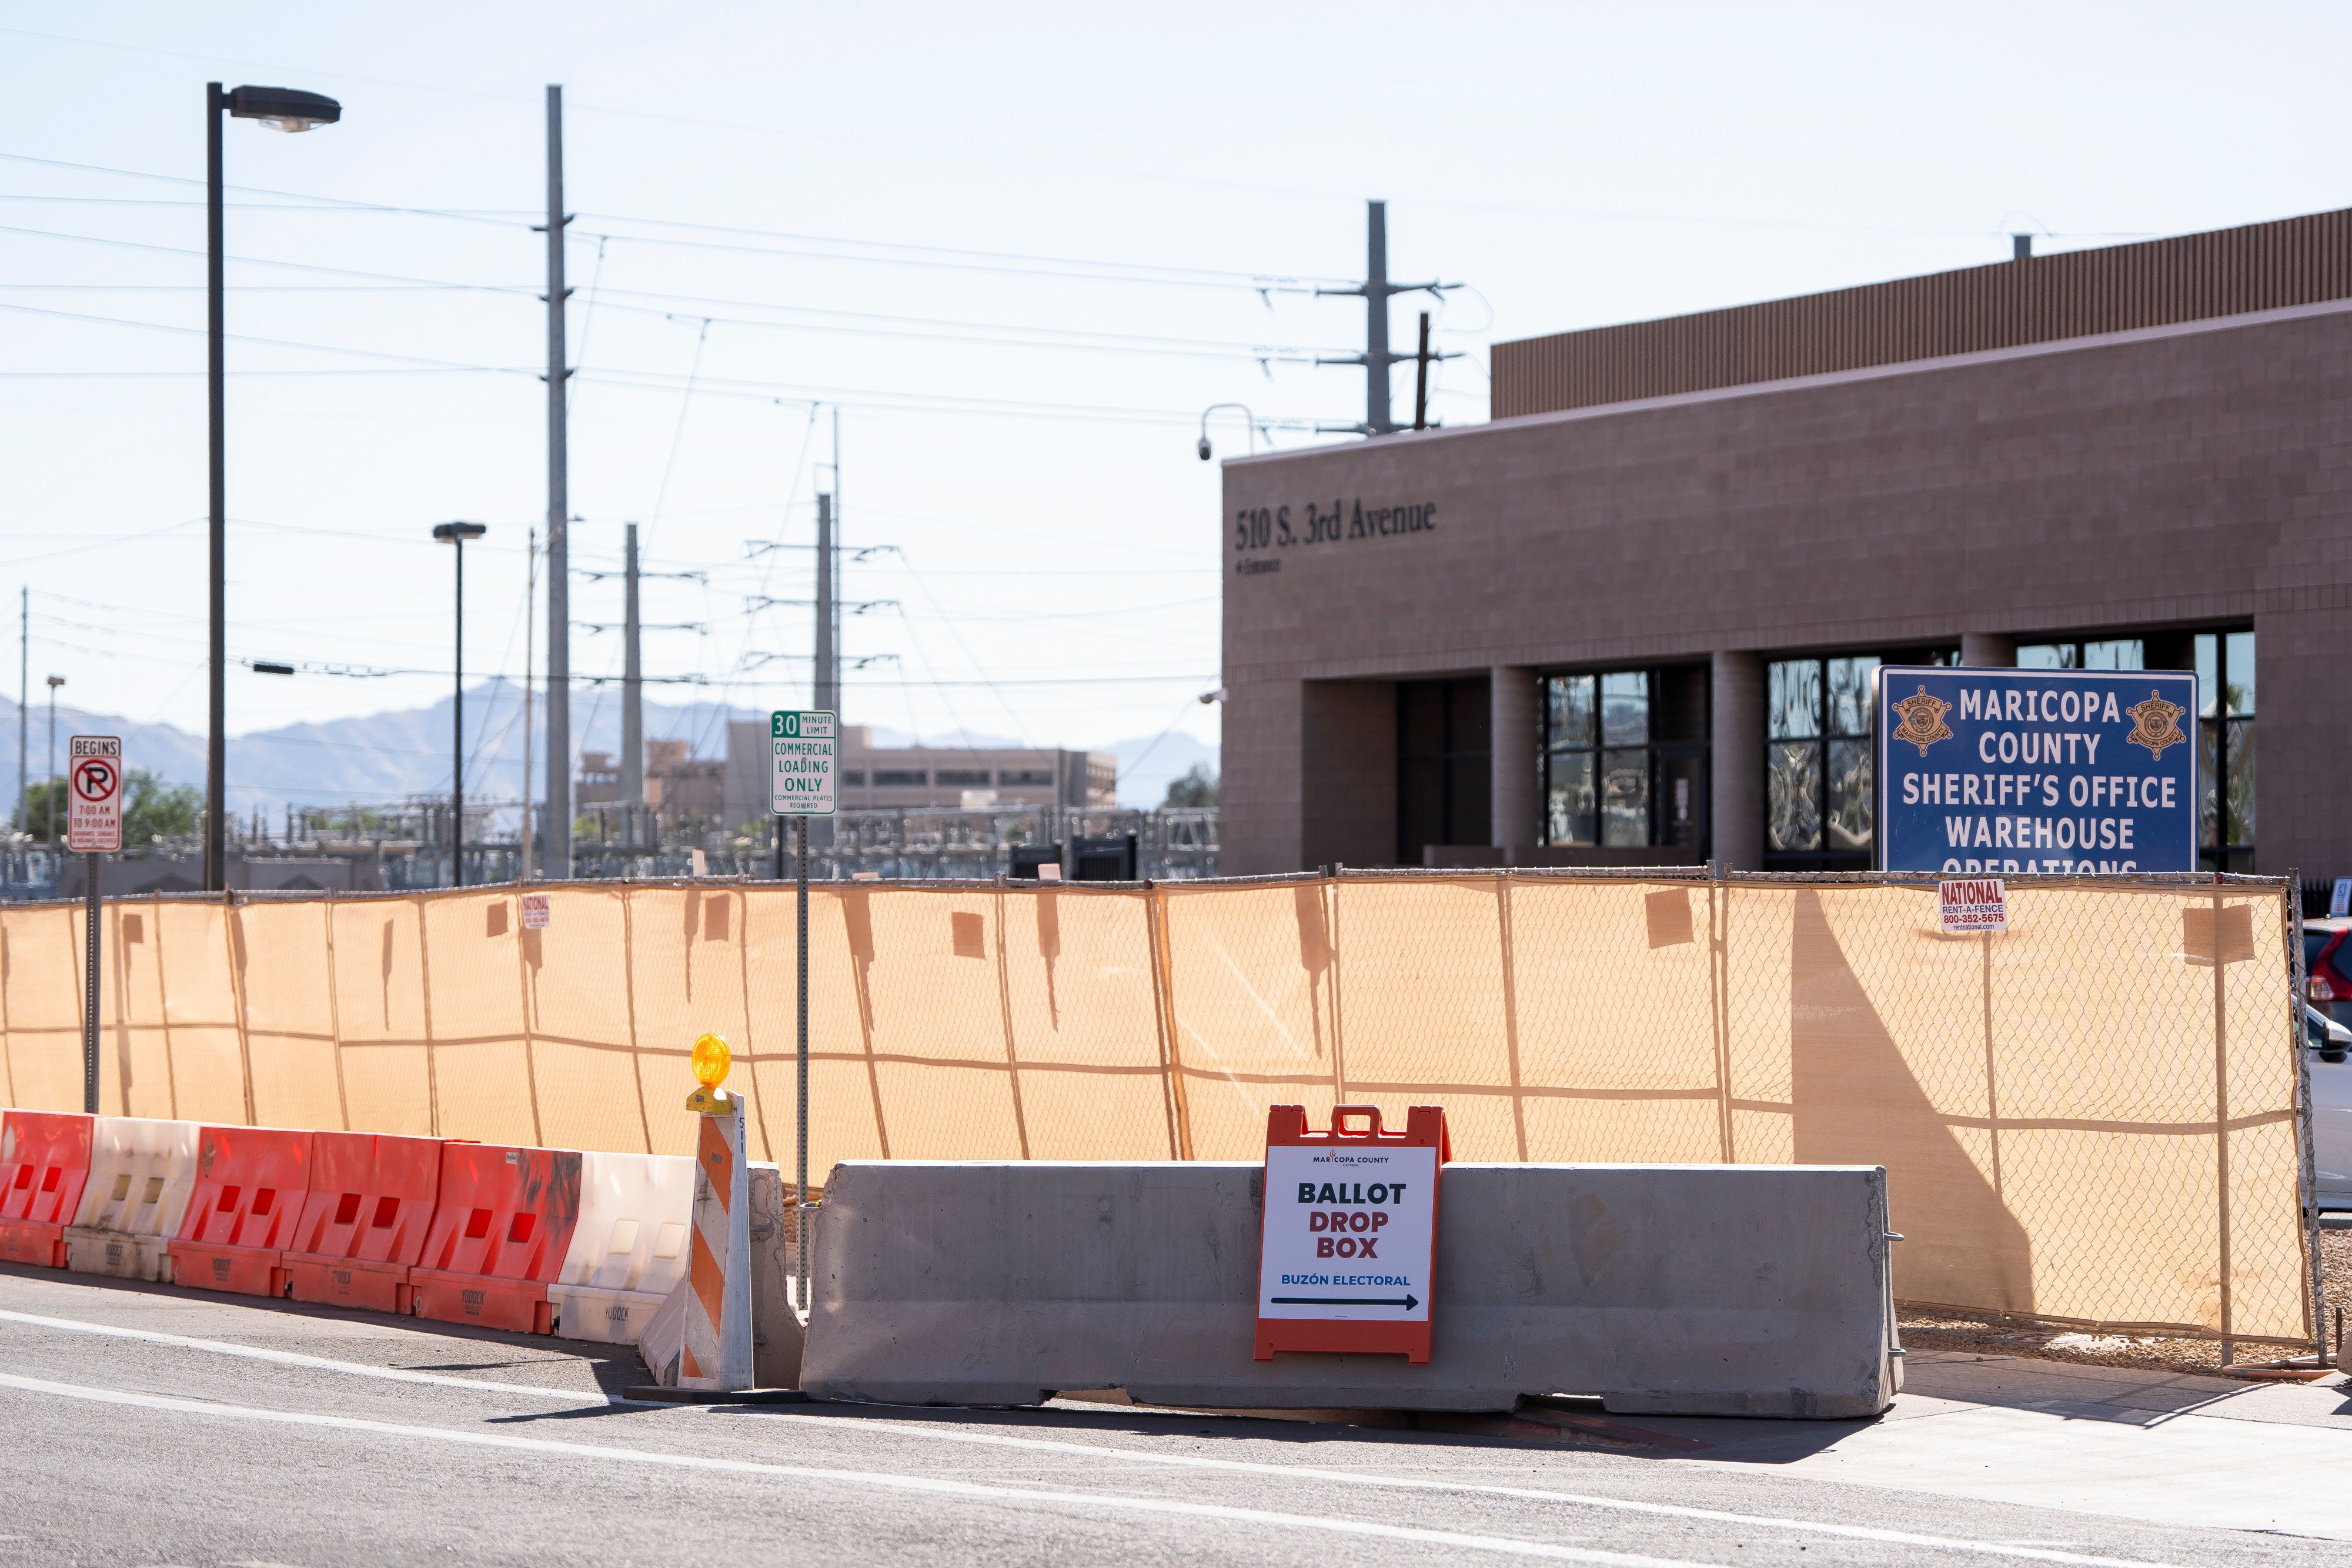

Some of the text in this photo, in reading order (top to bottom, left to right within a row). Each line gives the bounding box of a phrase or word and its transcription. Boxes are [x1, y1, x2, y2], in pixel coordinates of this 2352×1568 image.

[1235, 497, 1436, 550] 510 S. 3rd Avenue
[1907, 698, 1937, 707] SHERIFF
[1960, 689, 2120, 723] MARICOPA
[2141, 702, 2170, 711] SHERIFF
[774, 715, 797, 735] 30
[1901, 727, 1945, 742] MARICOPA COUNTY
[2135, 731, 2178, 745] MARICOPA COUNTY
[75, 740, 116, 755] BEGINS
[775, 743, 832, 755] COMMERCIAL
[1979, 731, 2101, 765] COUNTY
[779, 760, 828, 773] LOADING
[784, 777, 822, 792] ONLY
[1903, 773, 2176, 808] SHERIFF'S OFFICE
[98, 805, 111, 814] AM
[74, 818, 82, 828] TO
[105, 818, 116, 828] AM
[1945, 816, 2134, 850] WAREHOUSE
[1942, 881, 2002, 905] NATIONAL
[1943, 905, 2004, 914] RENT-A-FENCE
[1944, 914, 2004, 924] 800-352-5675
[1298, 1183, 1406, 1204] BALLOT
[1309, 1211, 1388, 1232] DROP
[1317, 1237, 1378, 1258] BOX
[1281, 1272, 1411, 1286] BUZÓN ELECTORAL
